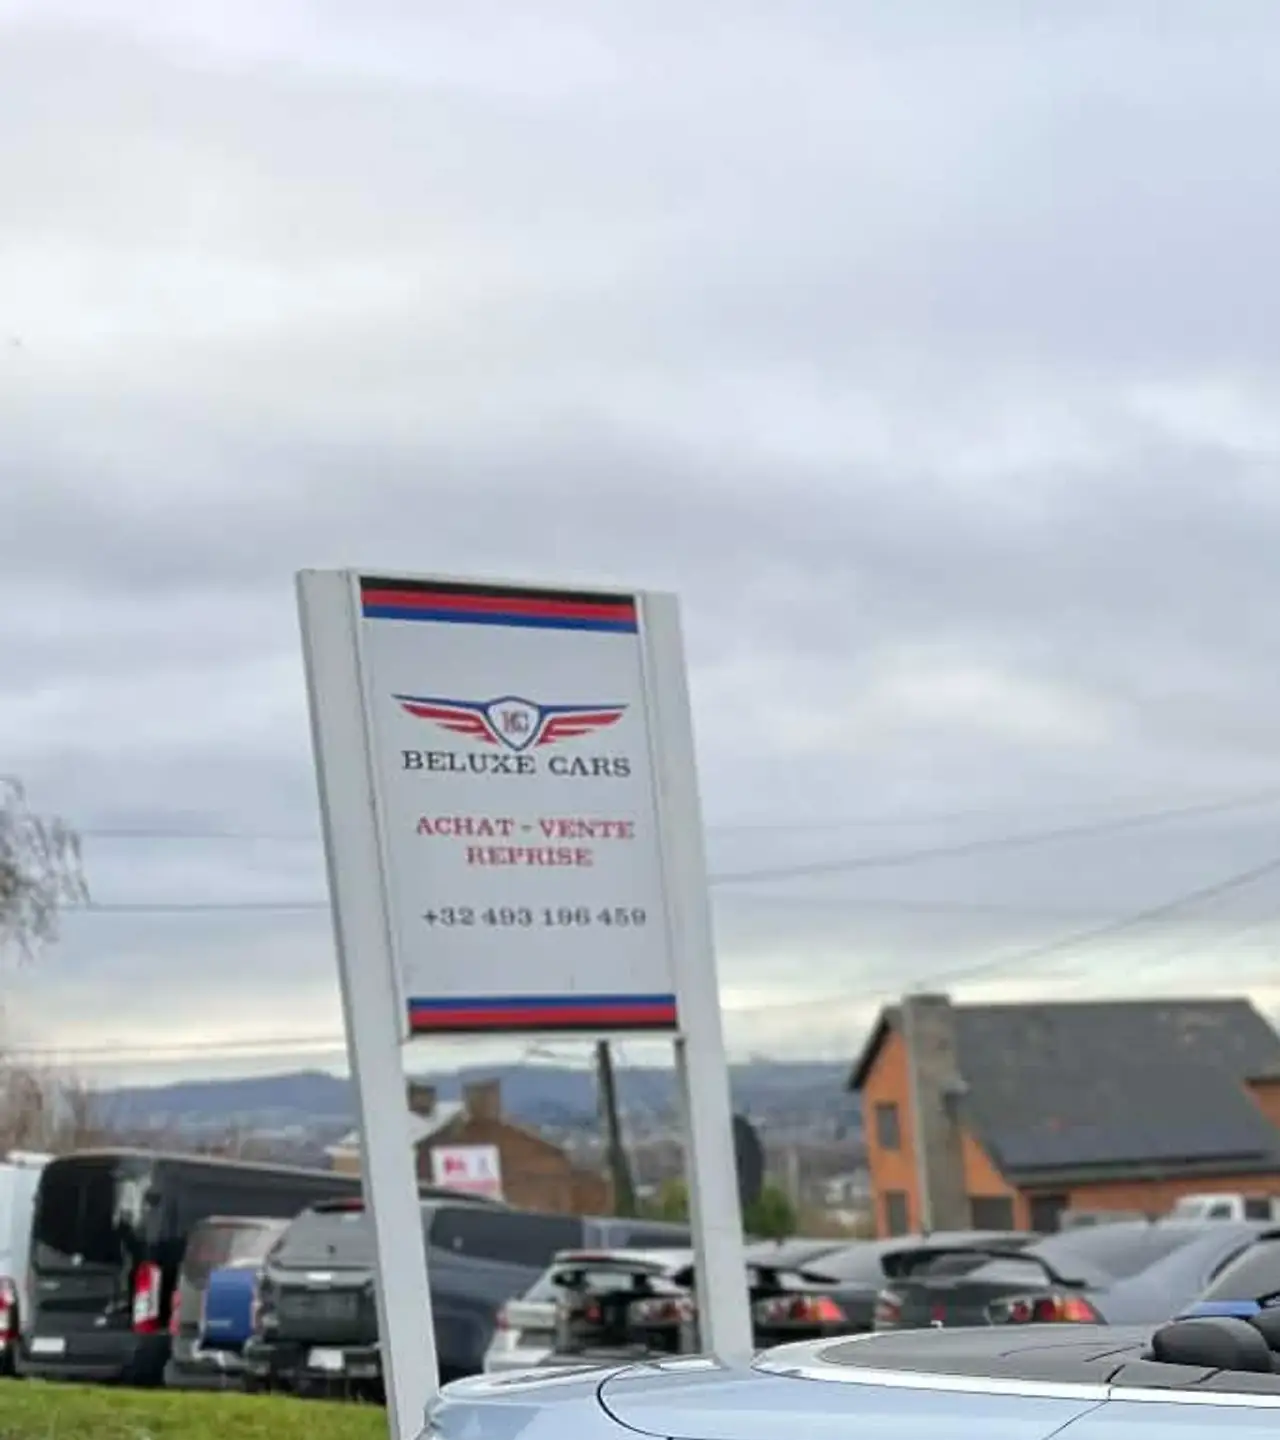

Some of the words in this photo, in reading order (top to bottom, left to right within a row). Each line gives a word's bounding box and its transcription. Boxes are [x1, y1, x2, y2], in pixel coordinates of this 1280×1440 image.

[402, 750, 536, 775] BELUXE
[548, 756, 631, 777] CARS
[416, 816, 514, 837] ACHAT
[540, 818, 635, 839] VENTE
[466, 846, 593, 866] REPRISE
[422, 907, 475, 926] +32
[481, 907, 533, 926] 493
[597, 907, 646, 926] 459
